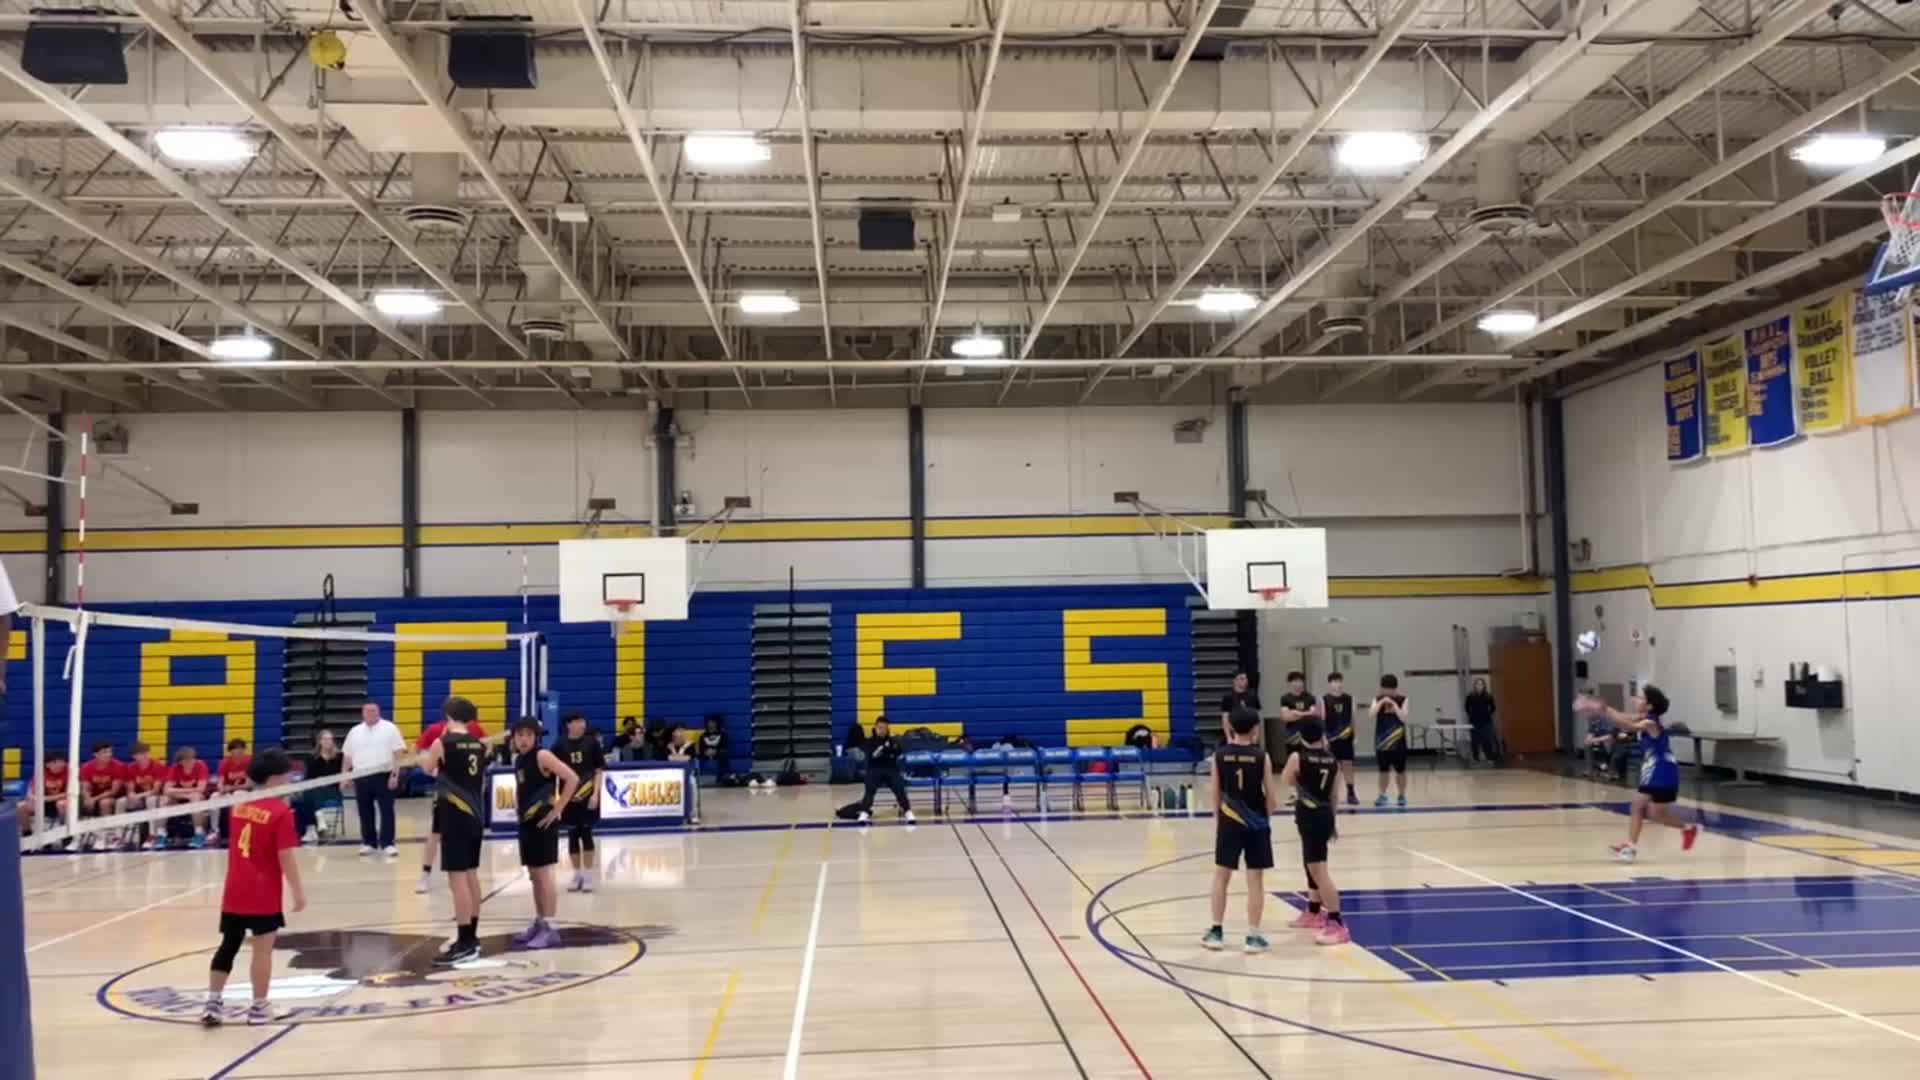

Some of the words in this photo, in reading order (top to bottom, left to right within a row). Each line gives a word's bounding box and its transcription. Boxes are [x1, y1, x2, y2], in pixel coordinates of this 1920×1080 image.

[467, 753, 479, 777] 3
[1235, 767, 1244, 791] 1
[1319, 768, 1330, 791] 7
[238, 822, 252, 859] 4
